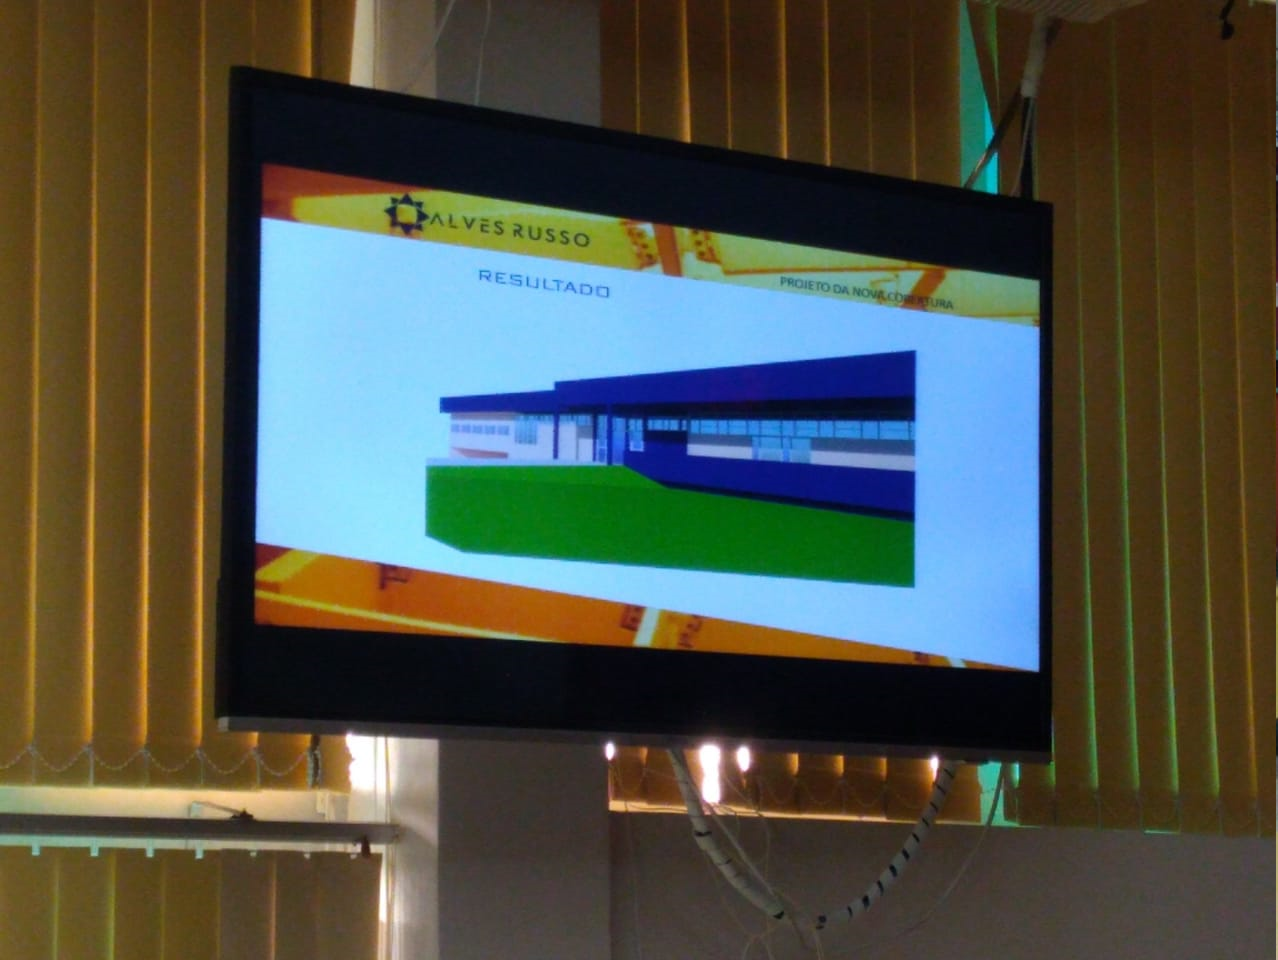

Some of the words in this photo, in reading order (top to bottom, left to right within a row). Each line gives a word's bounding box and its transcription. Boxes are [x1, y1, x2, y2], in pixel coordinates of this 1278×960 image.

[429, 211, 505, 236] ALVES
[512, 223, 591, 248] RUSSO
[478, 268, 611, 299] RESULTADO
[779, 276, 831, 293] PROJETO
[833, 283, 849, 295] DA
[852, 286, 886, 302] NOVA
